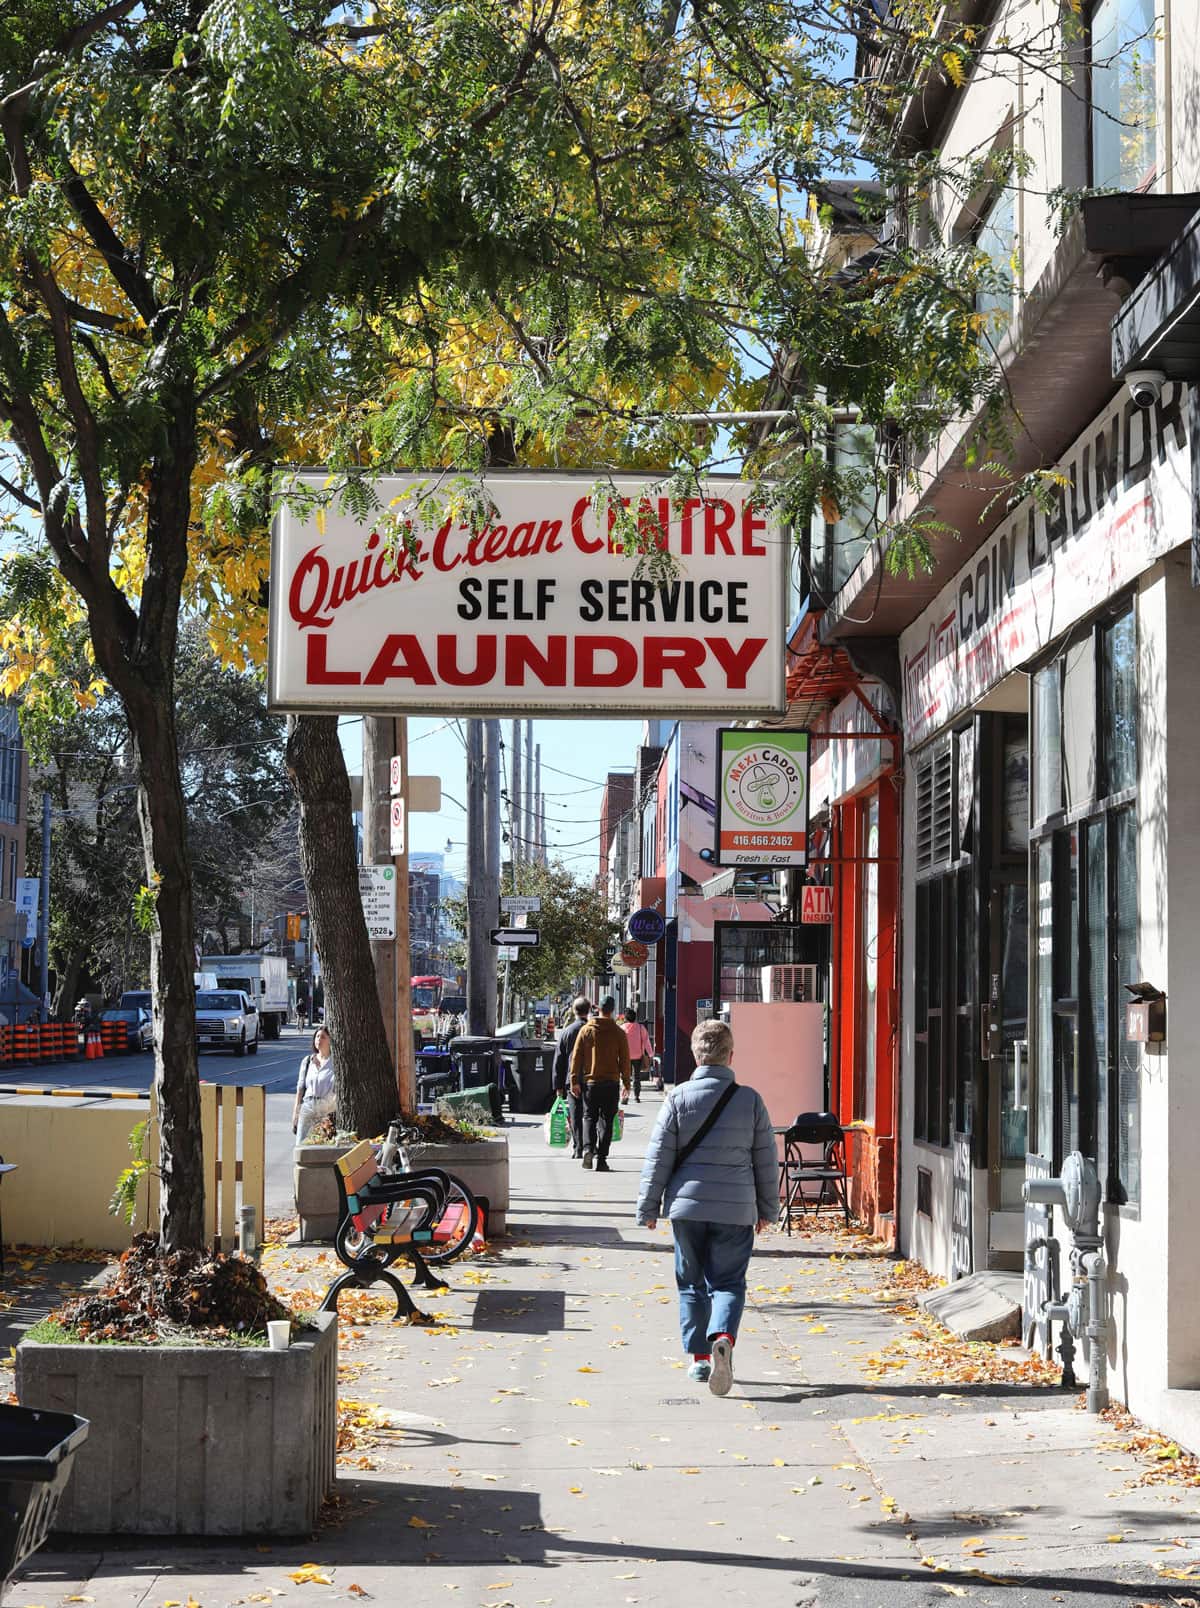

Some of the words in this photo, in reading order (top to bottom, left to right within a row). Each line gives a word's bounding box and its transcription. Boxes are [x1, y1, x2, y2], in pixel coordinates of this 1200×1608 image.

[571, 496, 767, 556] CENTRE
[959, 523, 1017, 643] COIN
[1028, 381, 1188, 568] LAUNDR
[457, 577, 556, 621] SELF
[579, 579, 749, 623] SERVICE
[307, 634, 768, 689] LAUNDRY
[729, 753, 758, 782] MEXI
[762, 750, 799, 782] CADOS
[735, 800, 765, 822] Burritos
[773, 801, 795, 820] Bowls
[732, 835, 793, 846] 416.466.2462
[735, 854, 760, 863] Fresh
[770, 854, 791, 863] Fast
[803, 913, 832, 922] INSID
[953, 1187, 969, 1228] AND
[951, 1232, 970, 1274] FOLD
[1023, 1270, 1049, 1325] FOLD
